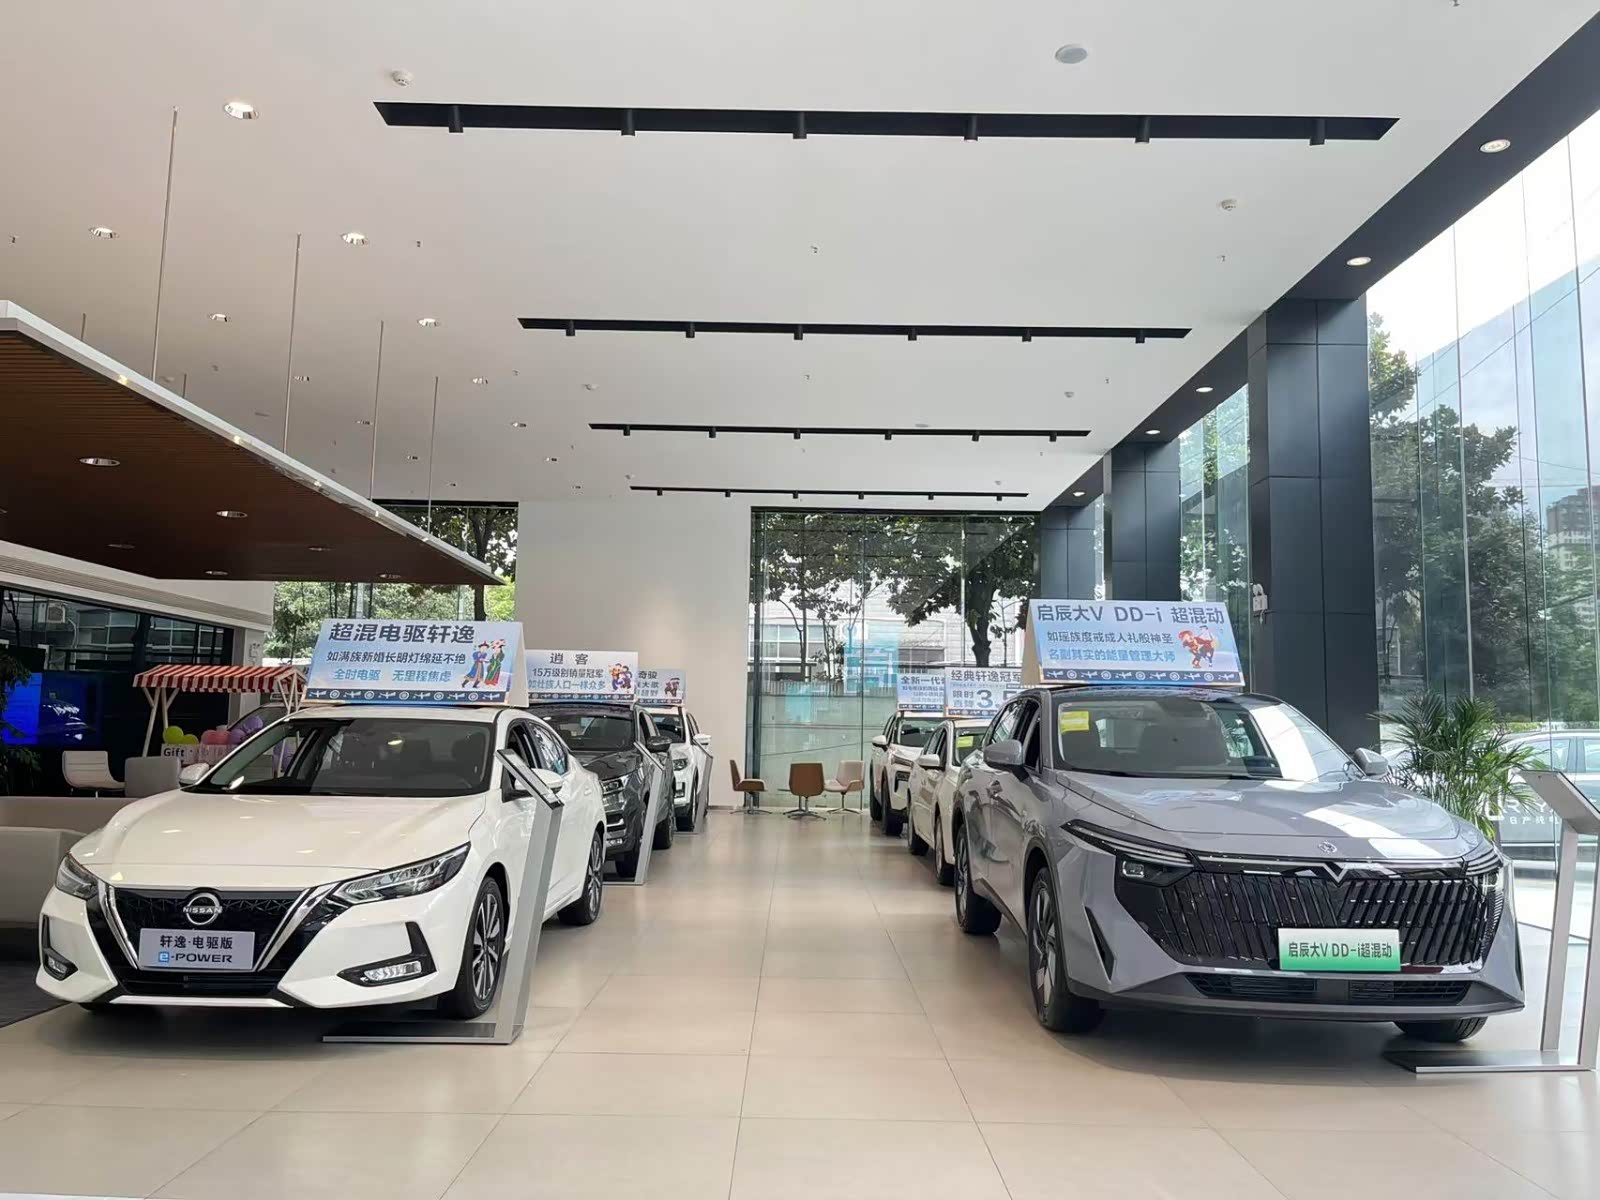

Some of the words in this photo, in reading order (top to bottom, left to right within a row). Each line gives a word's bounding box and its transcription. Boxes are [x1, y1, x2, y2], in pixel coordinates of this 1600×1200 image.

[1038, 605, 1103, 622] 启辰大V
[1115, 606, 1162, 622] DD-i
[1171, 608, 1225, 624] 超混动
[328, 623, 475, 644] 超混电驱轩逸
[1047, 631, 1174, 644] 如瑶族度戒成人礼般神圣
[326, 651, 466, 665] 如满族新婚长明灯绵延不绝
[1049, 650, 1176, 663] 名副其实的能量管理大师
[333, 669, 381, 681] 全时电驱
[392, 669, 451, 683] 无里程焦虑
[163, 748, 185, 757] Gift
[182, 905, 223, 914] NISSAN
[160, 935, 233, 949] 轩逸·电驱版
[158, 951, 233, 963] e-POWER
